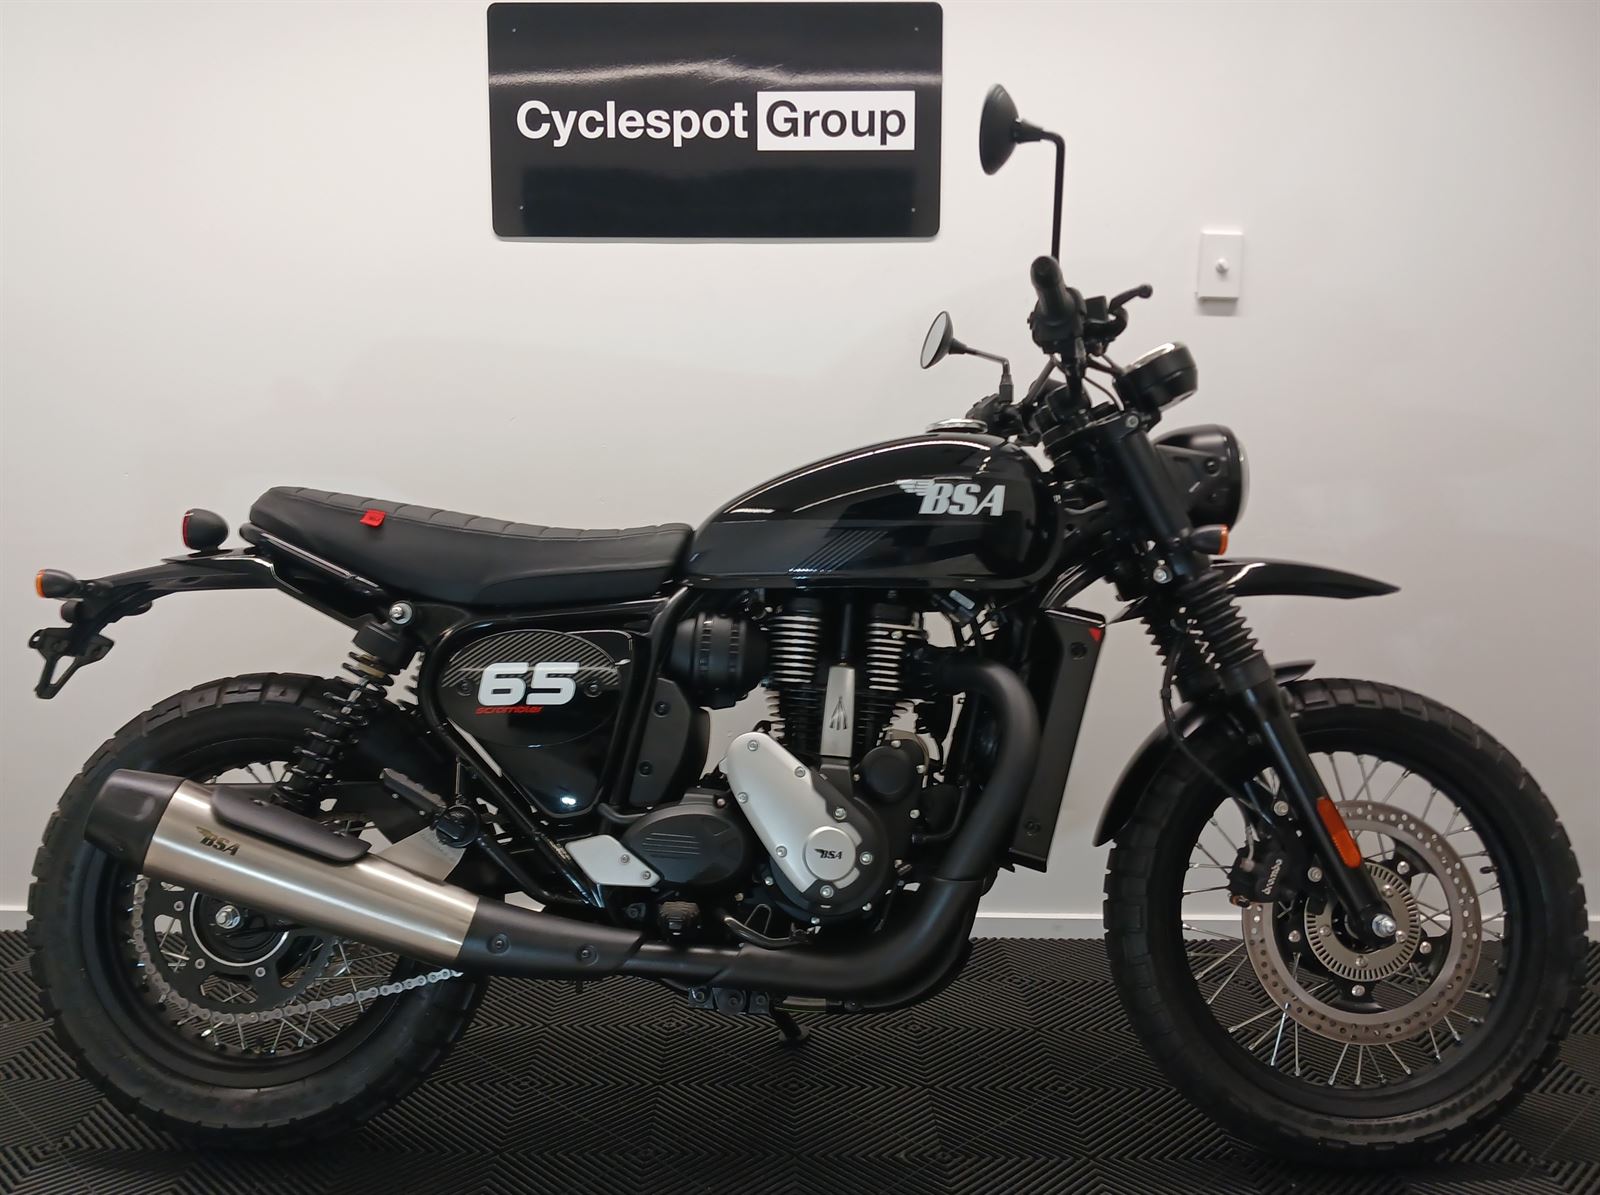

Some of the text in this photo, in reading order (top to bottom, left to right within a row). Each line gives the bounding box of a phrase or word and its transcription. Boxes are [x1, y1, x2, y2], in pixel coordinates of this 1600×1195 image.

[516, 100, 906, 147] Cyclespot Group
[917, 482, 1006, 517] BSA
[477, 661, 580, 706] 65
[199, 834, 241, 856] BSA
[818, 849, 843, 860] BSA
